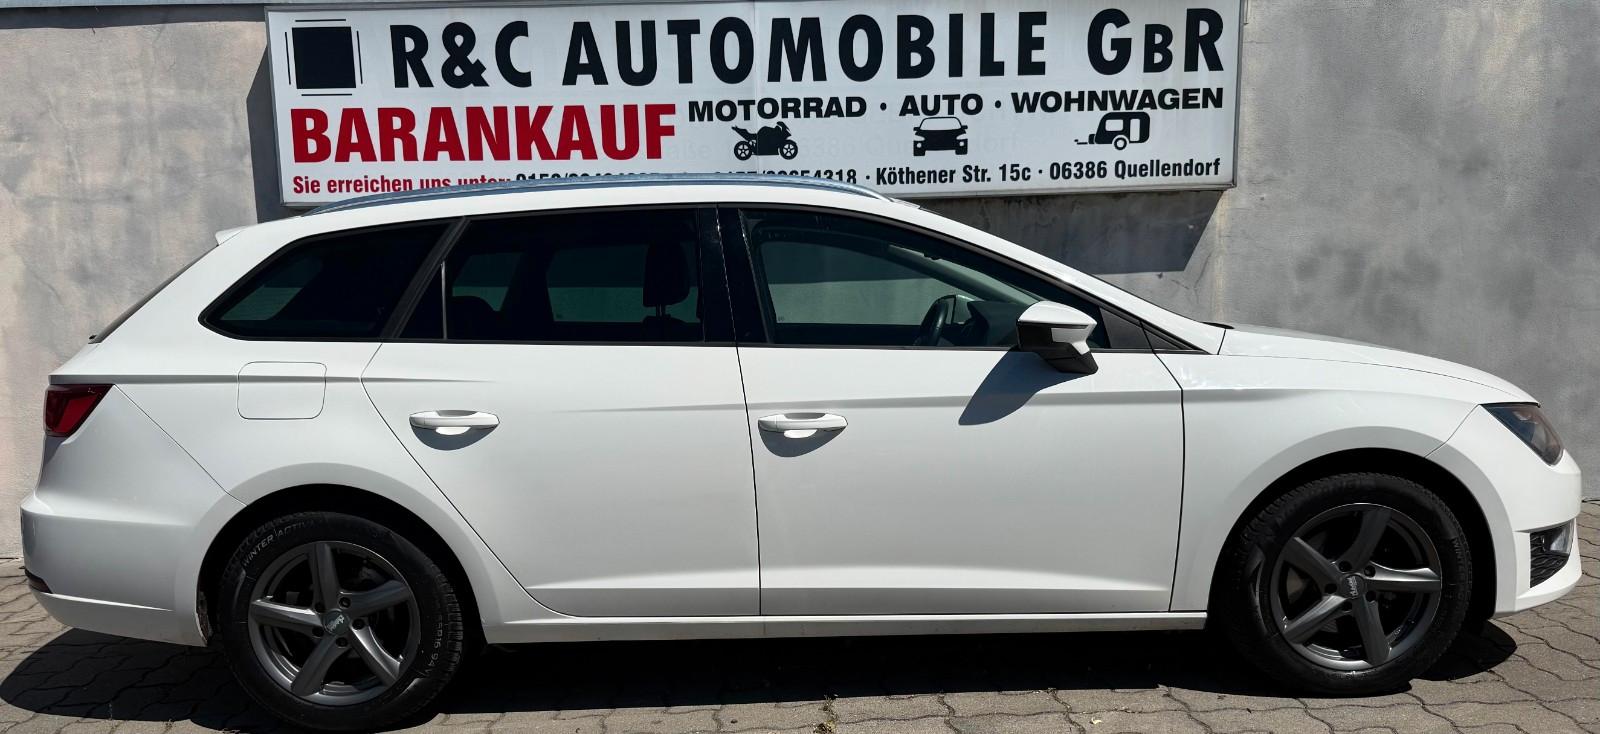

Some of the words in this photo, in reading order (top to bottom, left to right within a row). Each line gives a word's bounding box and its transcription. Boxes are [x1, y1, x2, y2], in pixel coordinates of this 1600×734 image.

[389, 21, 533, 90] R&C
[562, 11, 1049, 87] AUTOMOBILE
[688, 96, 867, 123] MOTORRAD
[898, 93, 984, 117] AUTO
[1010, 87, 1224, 114] WOHNWAGEN
[291, 104, 676, 164] BARANKAUF
[292, 175, 321, 194] Sie
[326, 175, 412, 194] erreichen
[876, 167, 957, 186] Köthener
[962, 165, 992, 184] Str.
[998, 164, 1032, 182] 15c
[1049, 162, 1108, 181] 06386
[1114, 162, 1221, 180] Quellendorf
[242, 534, 274, 566] WINTER
